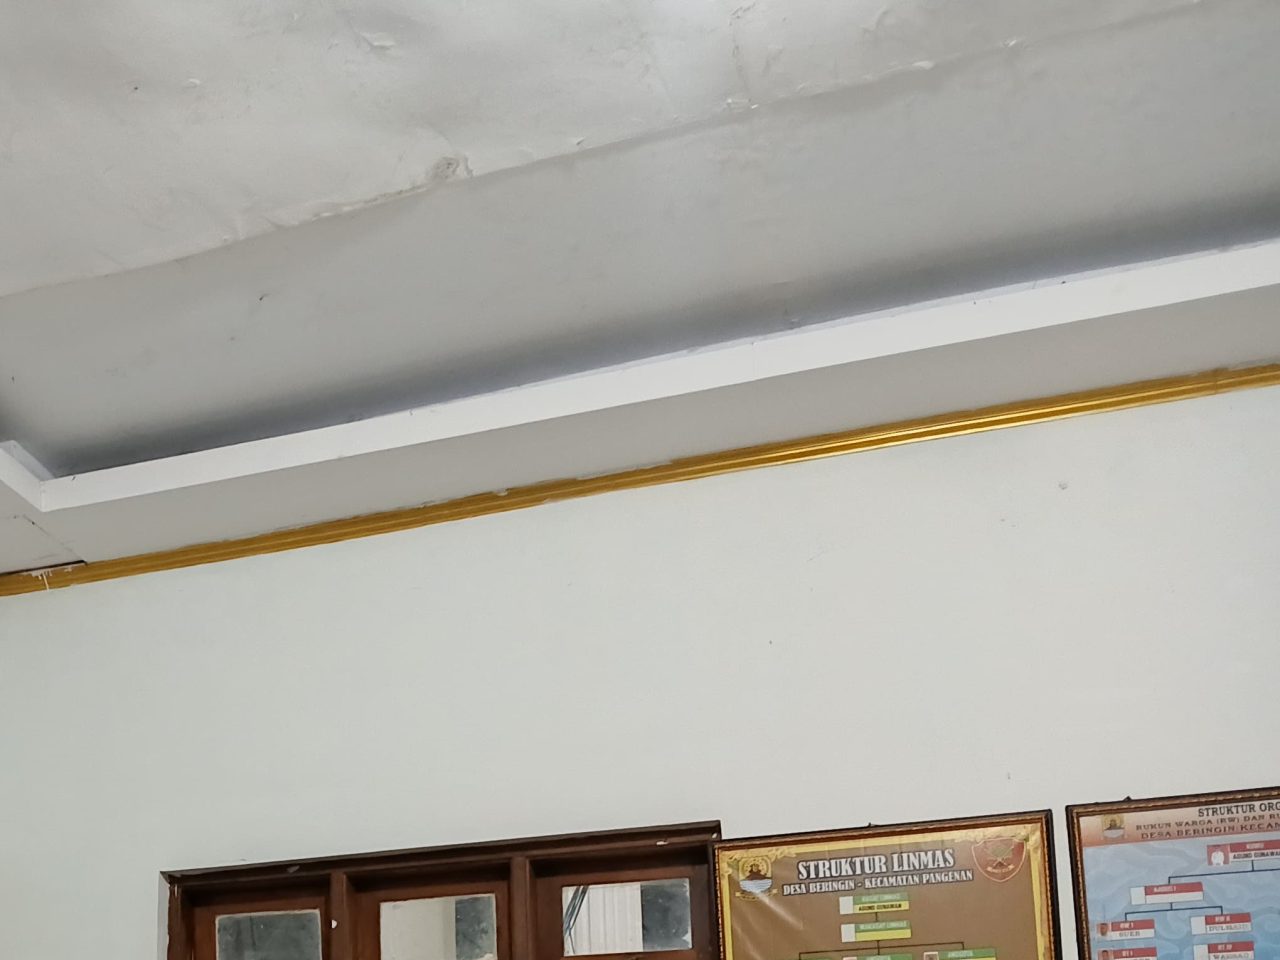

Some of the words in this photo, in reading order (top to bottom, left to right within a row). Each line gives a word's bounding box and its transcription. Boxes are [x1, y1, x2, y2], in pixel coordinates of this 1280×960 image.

[1198, 803, 1257, 817] STRUKTUR
[1175, 819, 1213, 827] WARGA
[1141, 831, 1171, 839] DESA
[1177, 826, 1235, 836] BERINGIN
[798, 855, 888, 880] STRUKTUR
[892, 848, 955, 872] LINMAS
[782, 882, 807, 896] DESA
[809, 879, 856, 893] BERINGIN
[865, 874, 920, 889] KECAMATAN
[922, 870, 974, 885] PANGENAN
